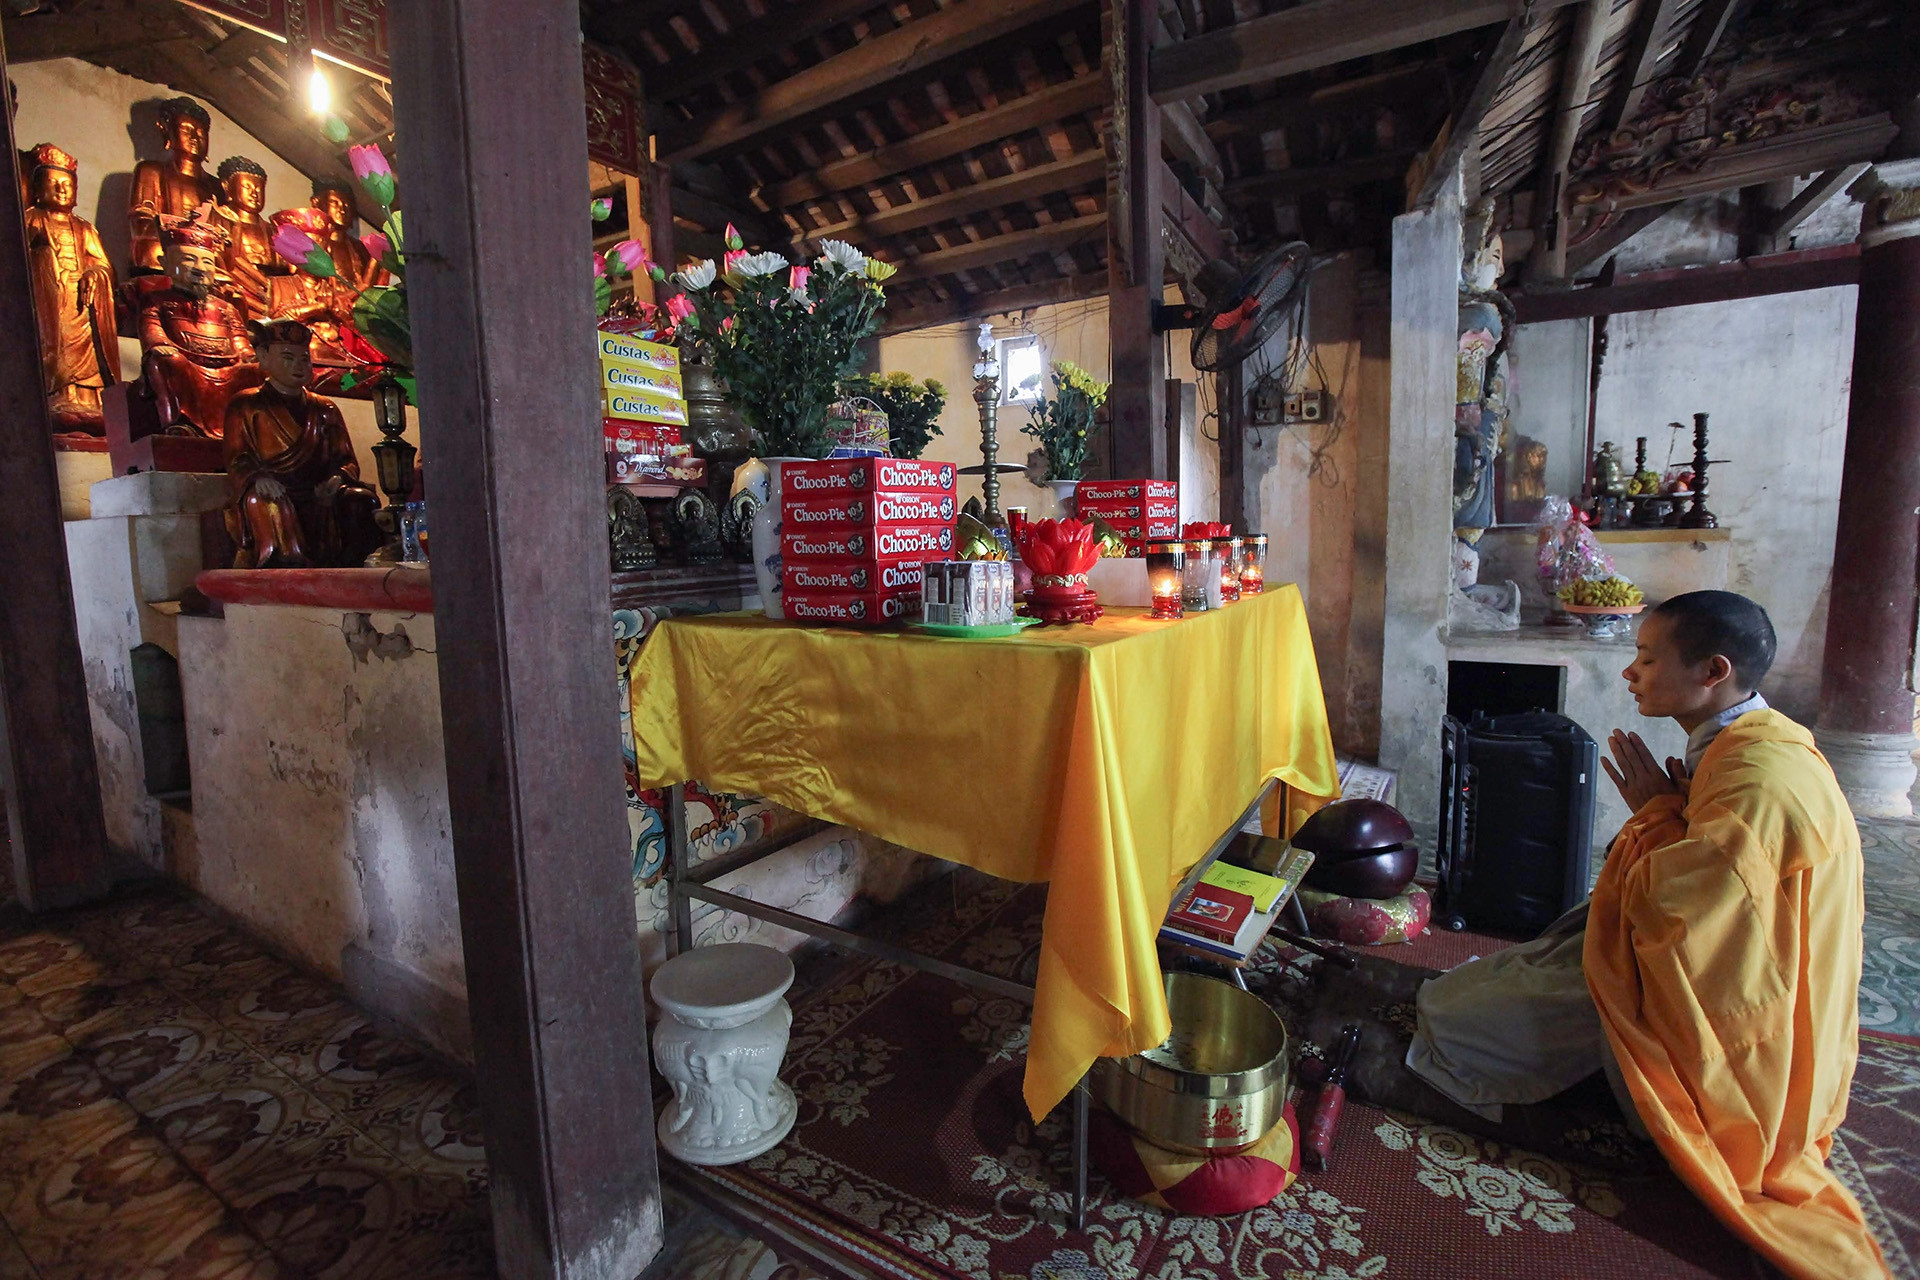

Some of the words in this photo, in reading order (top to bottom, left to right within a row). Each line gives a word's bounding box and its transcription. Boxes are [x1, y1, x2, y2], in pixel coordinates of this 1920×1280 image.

[603, 339, 650, 361] Custas
[608, 369, 655, 386] Custas
[613, 397, 660, 415] Custas
[883, 568, 921, 588] Choco
